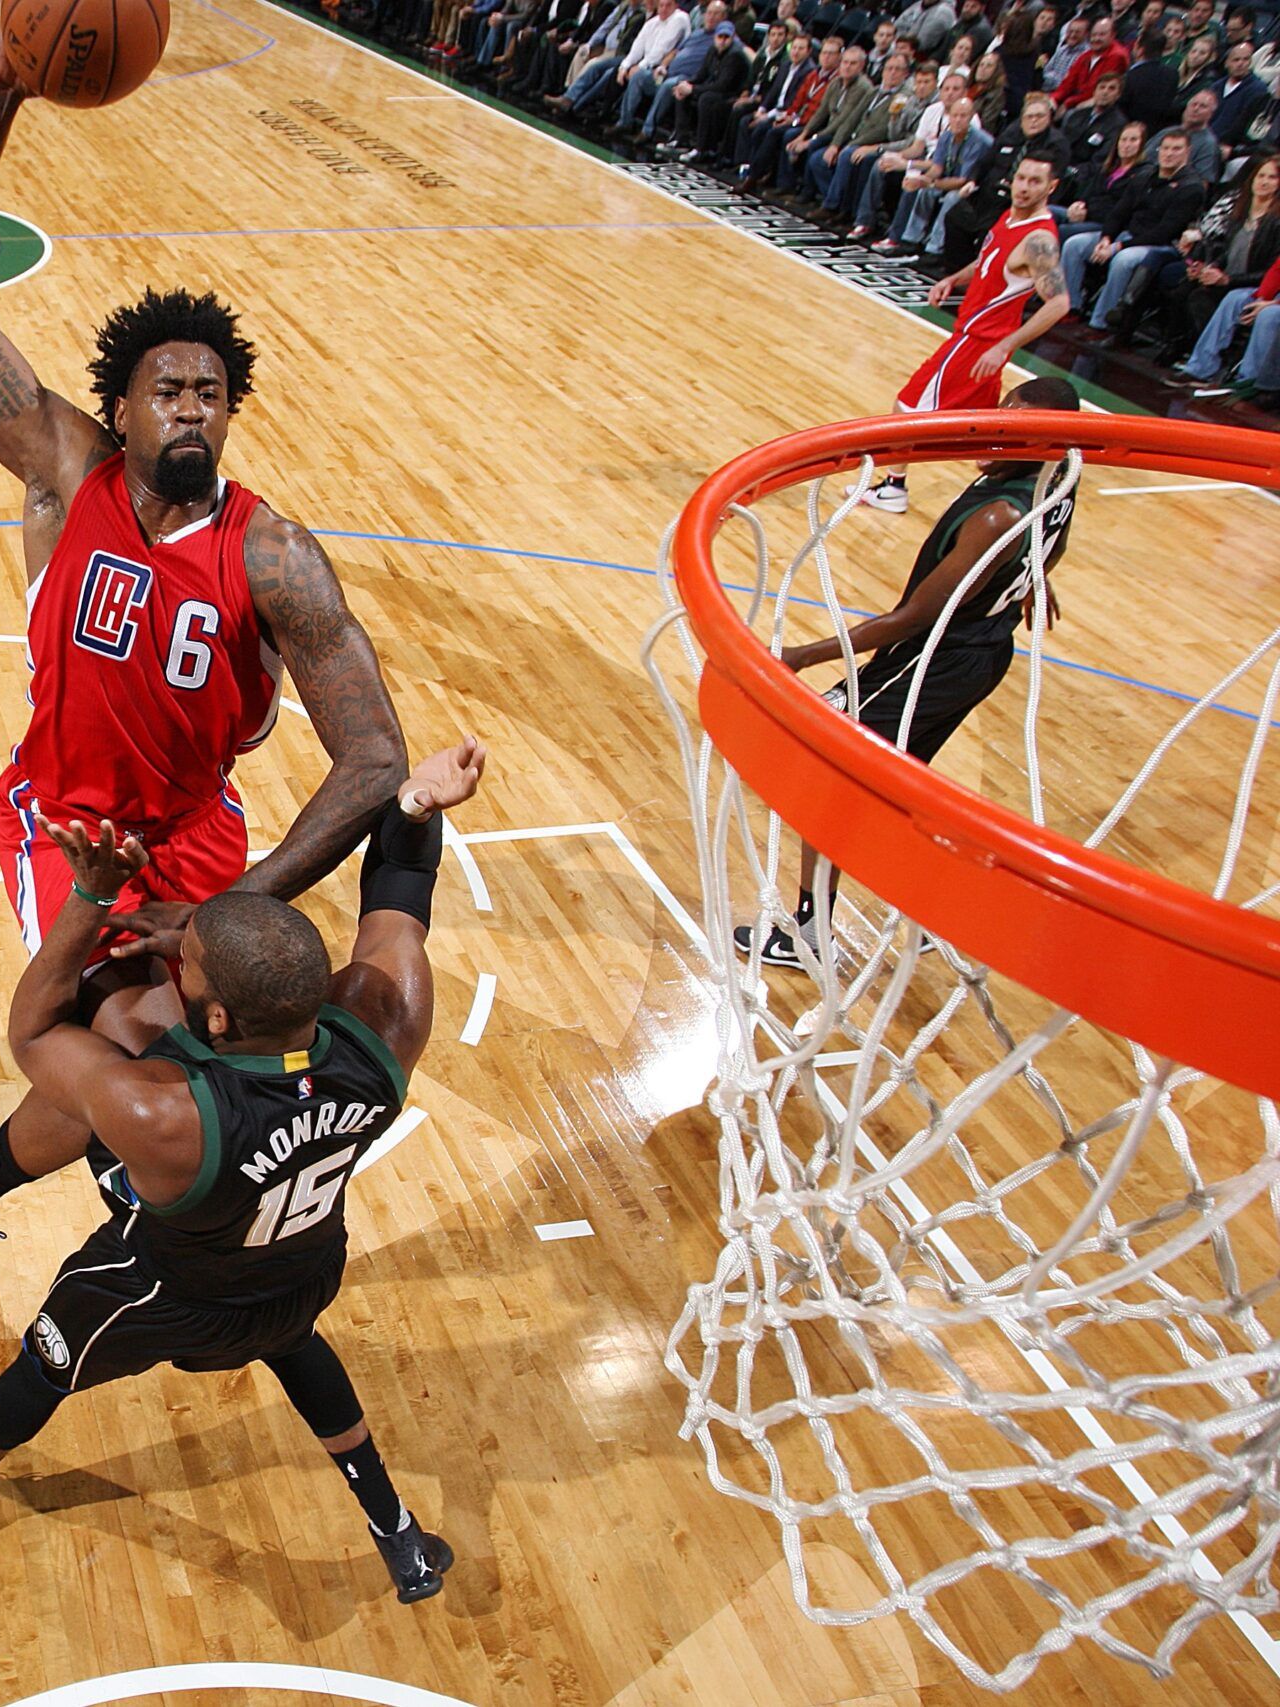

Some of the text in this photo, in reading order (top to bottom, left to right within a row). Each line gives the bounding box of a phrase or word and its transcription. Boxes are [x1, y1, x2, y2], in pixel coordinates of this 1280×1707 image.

[352, 136, 459, 189] BRADLEY
[166, 599, 220, 690] 6
[239, 1101, 387, 1185] MONROE
[242, 1143, 357, 1248] 15
